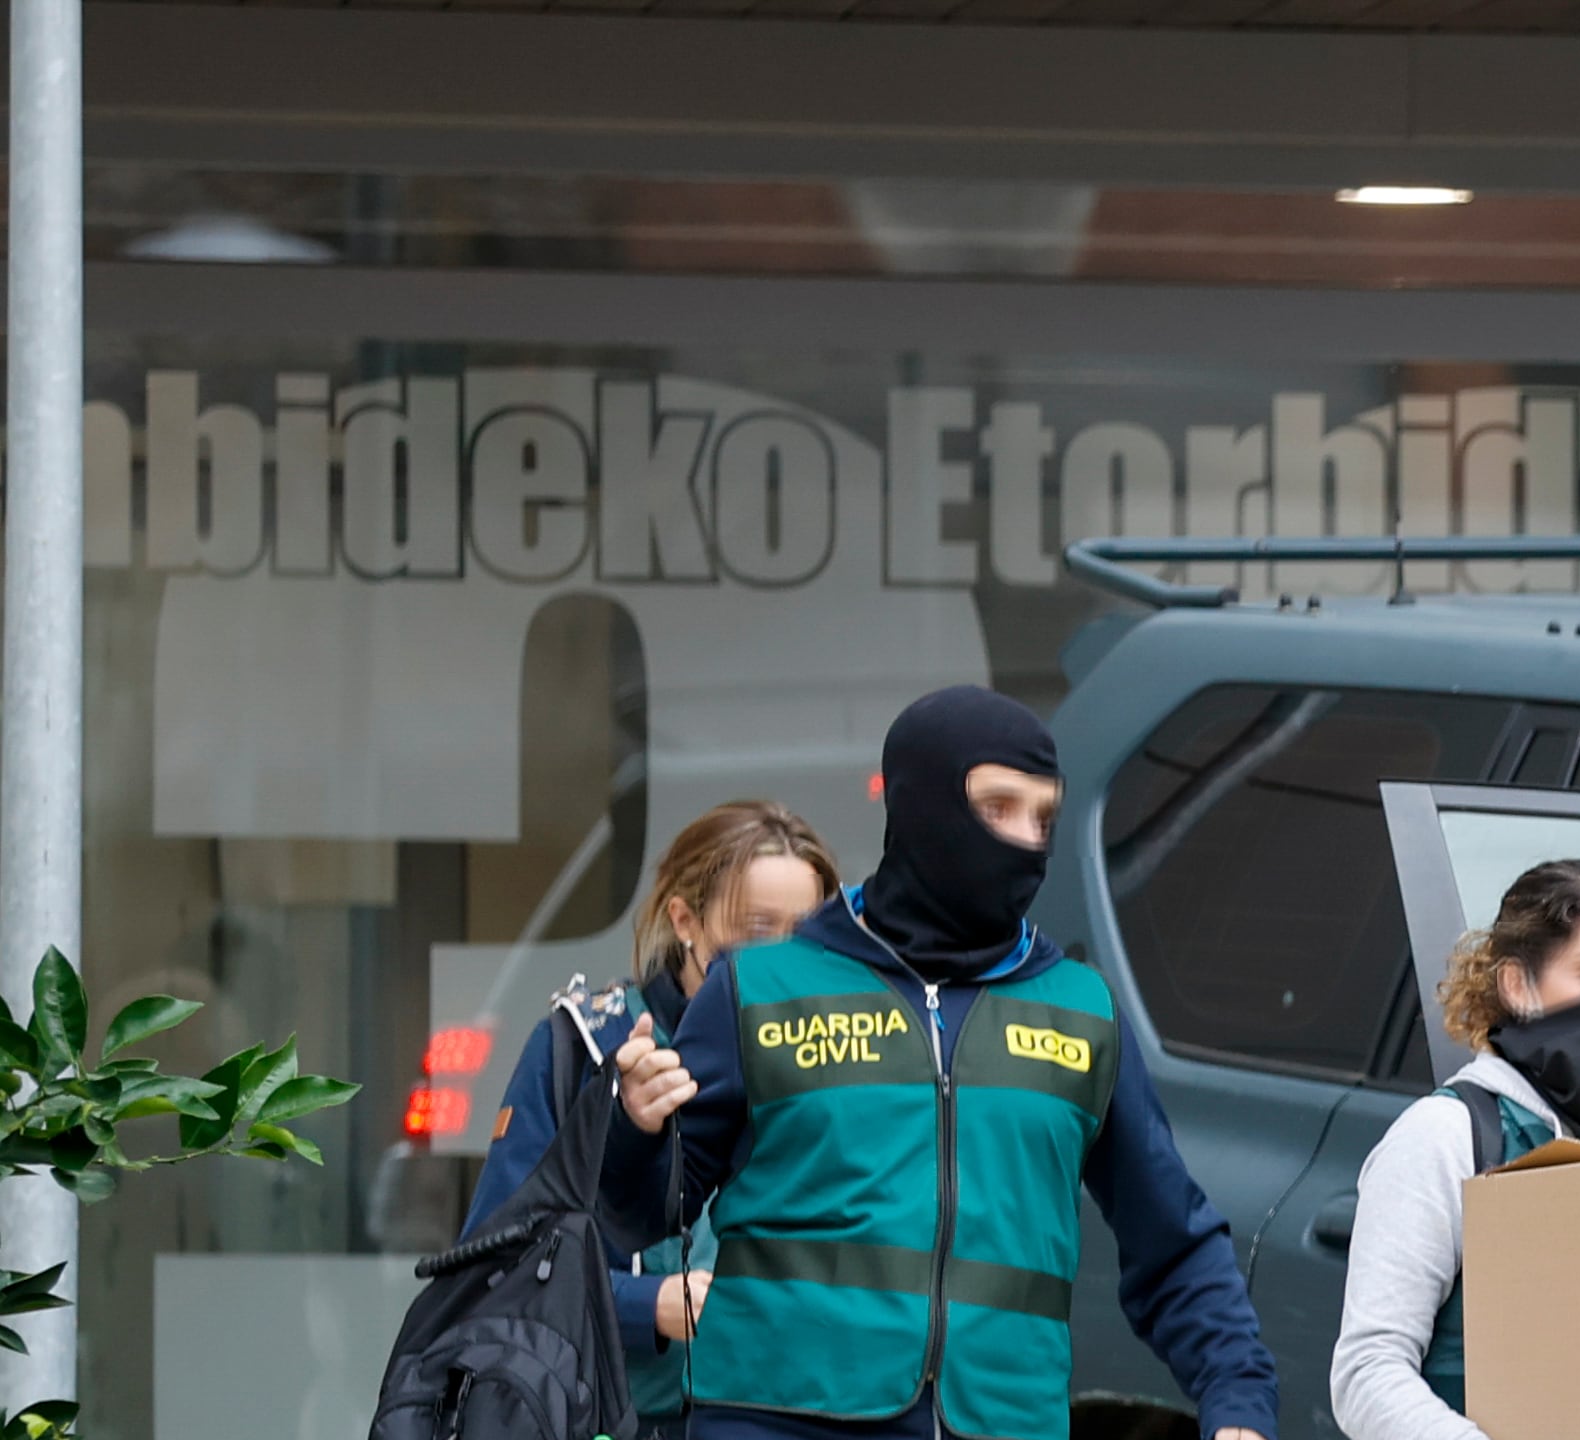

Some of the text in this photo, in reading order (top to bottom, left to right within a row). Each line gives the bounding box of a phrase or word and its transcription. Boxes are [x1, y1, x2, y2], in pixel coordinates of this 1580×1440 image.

[758, 1009, 908, 1048] GUARDIA
[796, 1037, 881, 1069] CIVIL
[1015, 1029, 1082, 1063] UCO
